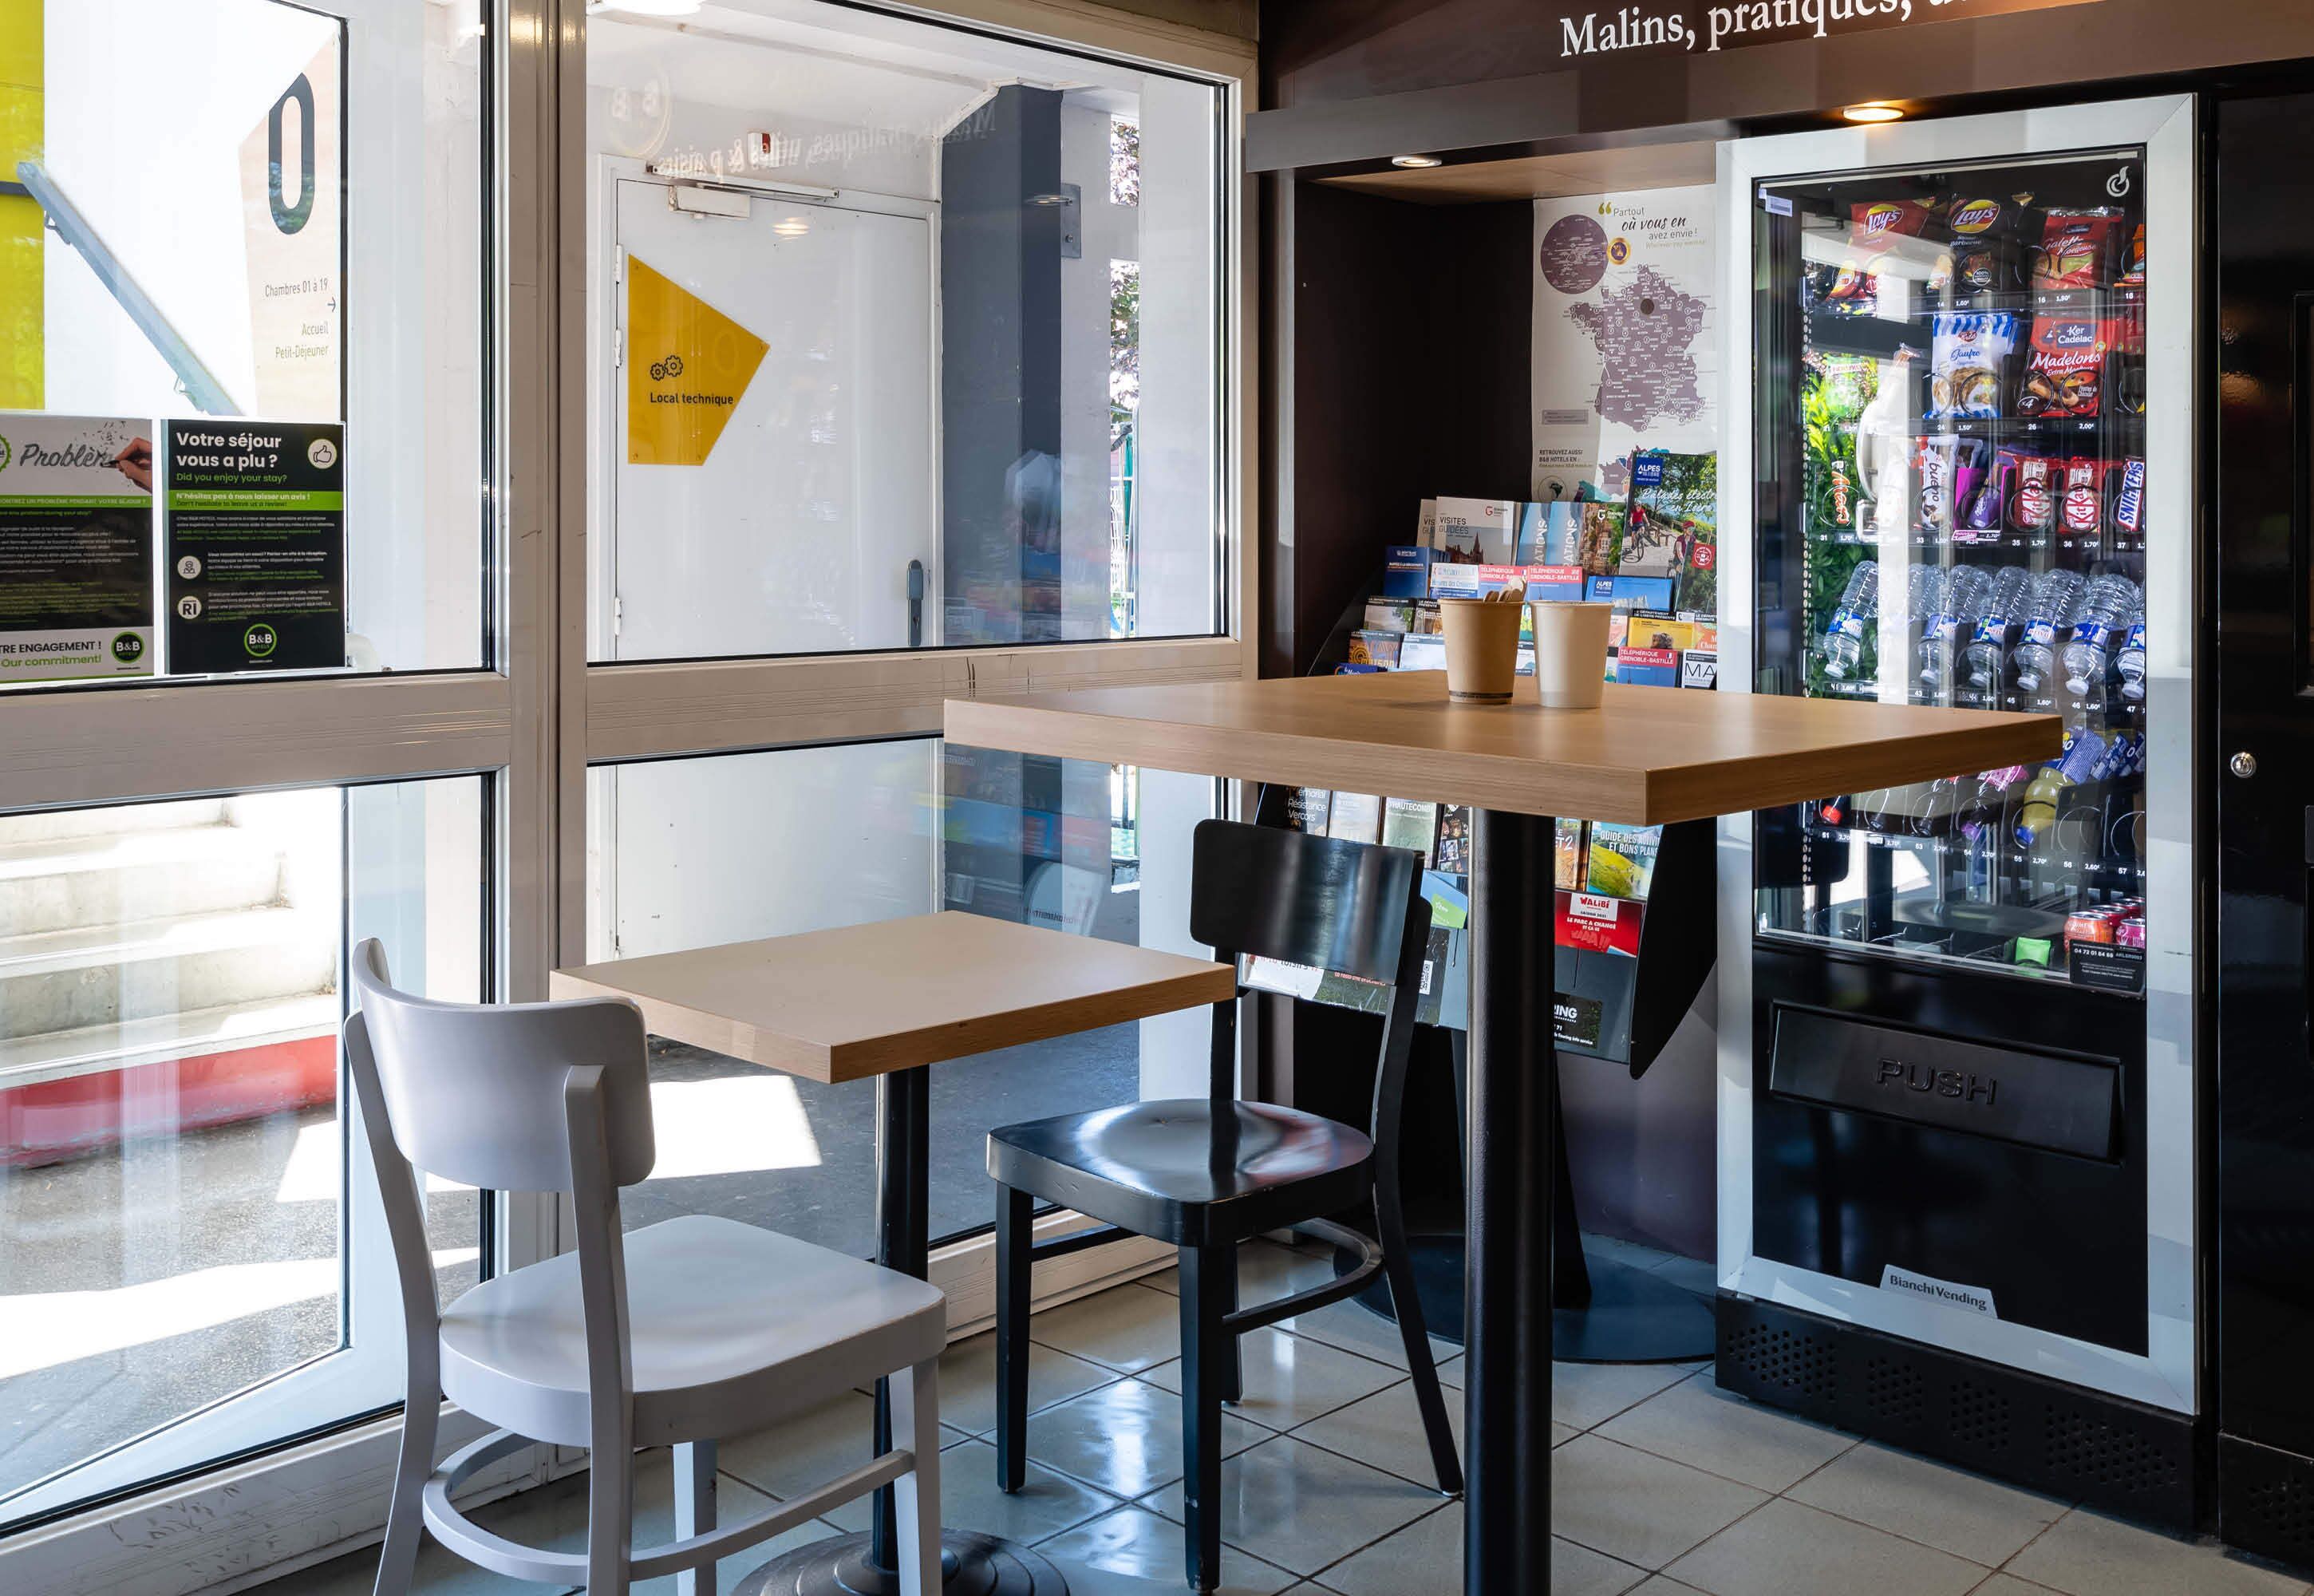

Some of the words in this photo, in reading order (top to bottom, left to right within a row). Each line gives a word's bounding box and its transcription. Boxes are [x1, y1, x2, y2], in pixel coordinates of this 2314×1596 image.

[1561, 7, 1695, 57] Malins,
[1613, 207, 1645, 216] Partout
[1622, 217, 1636, 231] où
[1641, 218, 1667, 230] vous
[1671, 217, 1686, 227] en
[1670, 230, 1692, 239] envie
[266, 284, 301, 297] Chambres
[302, 280, 311, 293] 01
[314, 278, 318, 292] à
[320, 277, 328, 291] 19
[302, 321, 329, 335] Accueil
[2067, 326, 2085, 336] Ker
[2059, 335, 2093, 344] Cadélac
[275, 345, 328, 361] Petit-Déjeuner
[2030, 351, 2101, 369] Madelons
[650, 392, 679, 404] Local
[682, 393, 733, 406] technique
[176, 433, 224, 446] Votre
[228, 433, 281, 452] séjour
[176, 455, 219, 467] vous
[223, 456, 234, 467] a
[239, 454, 265, 472] plu
[269, 454, 278, 468] ?
[194, 474, 211, 484] you
[214, 474, 238, 484] enjoy
[242, 474, 262, 484] your
[263, 474, 287, 484] stay?
[1929, 462, 1941, 503] bueno
[249, 634, 272, 645] B&B
[19, 642, 96, 654] ENGAGEMENT
[116, 642, 141, 653] B&B
[2, 658, 22, 668] Our
[25, 654, 102, 666] commitment!
[1620, 656, 1673, 665] GRENOBLE-BASTILLE
[1288, 798, 1326, 812] Résistance
[1289, 809, 1316, 822] Vercors
[1601, 830, 1622, 841] GUIDE
[1624, 833, 1637, 843] DES
[1609, 842, 1617, 851] ET
[1620, 843, 1638, 855] BONS
[1876, 1058, 1997, 1105] PUSH
